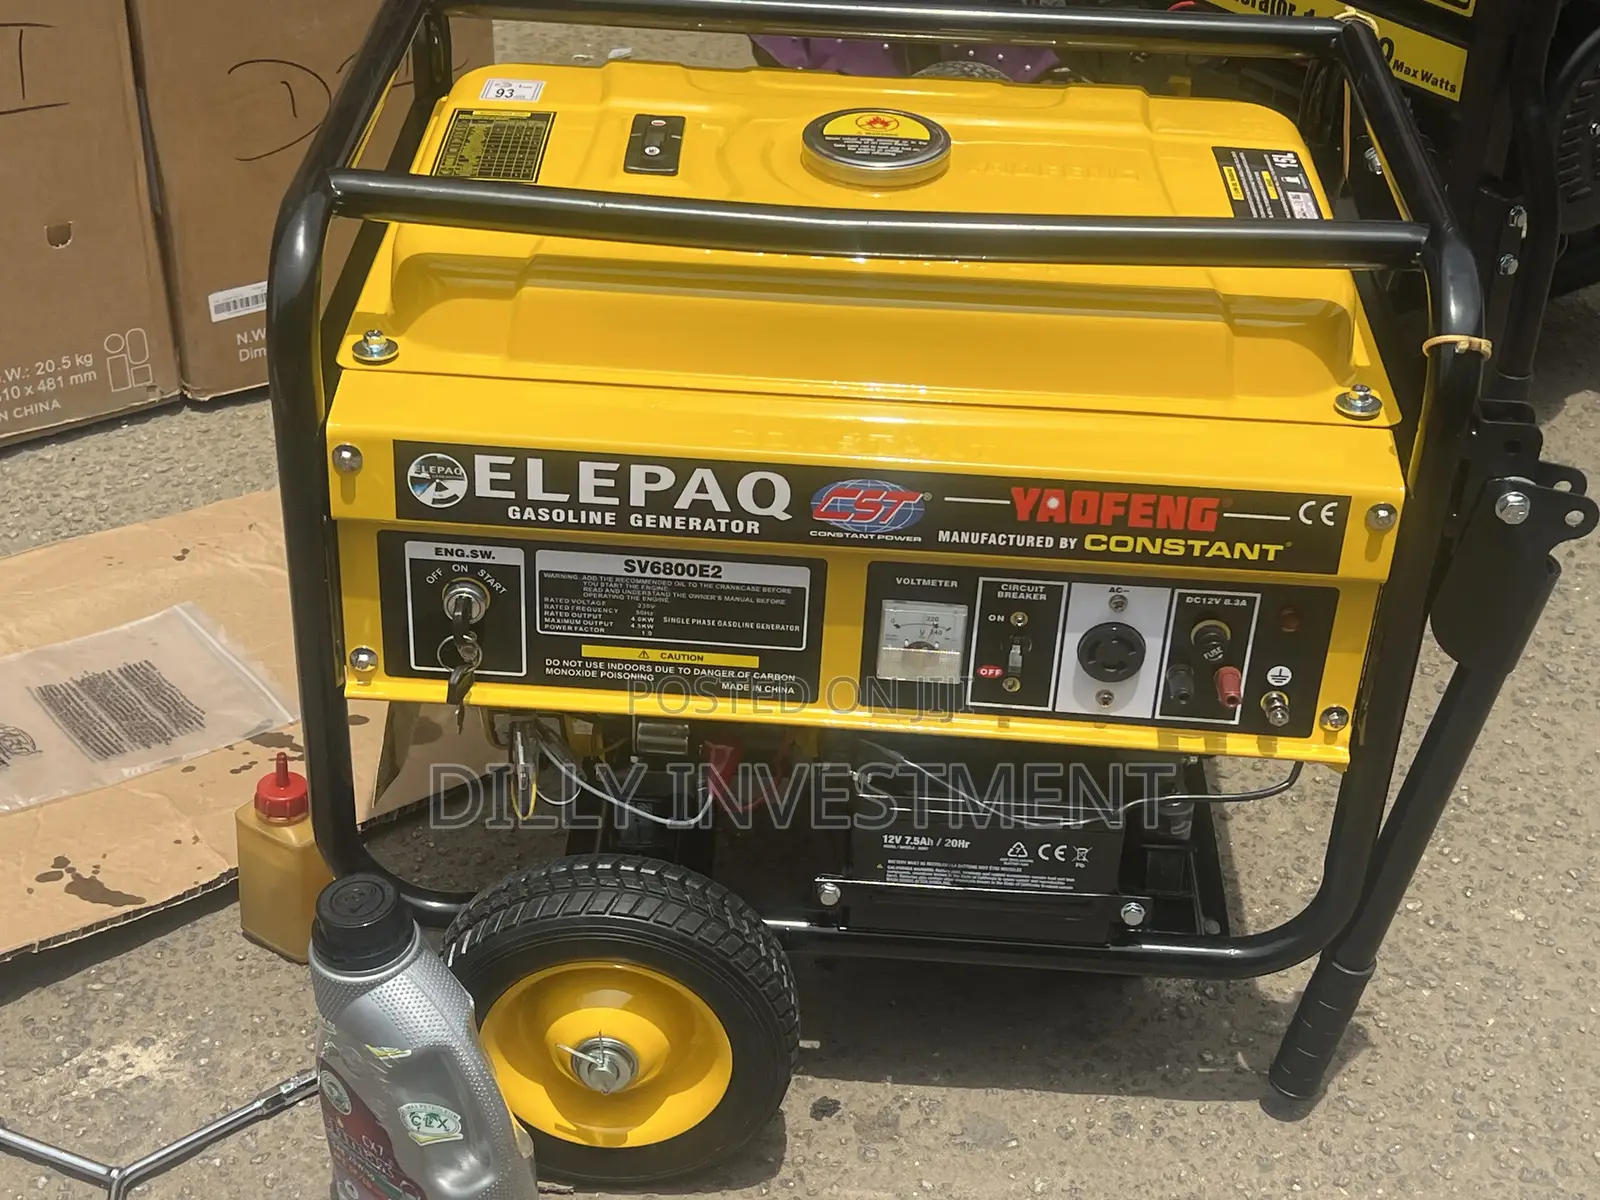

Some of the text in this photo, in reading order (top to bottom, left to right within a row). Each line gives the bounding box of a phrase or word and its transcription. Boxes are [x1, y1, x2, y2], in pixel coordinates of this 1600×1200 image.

[1392, 59, 1419, 78] Max
[1420, 69, 1457, 94] Watts
[494, 88, 515, 99] 93
[35, 355, 72, 375] 20.5
[75, 353, 93, 367] kg
[0, 370, 97, 402] 10 x 481 mm
[13, 399, 62, 419] CHINA
[474, 454, 793, 522] ELEPAQ
[812, 487, 924, 524] CST
[1011, 486, 1221, 532] YAOFENG
[507, 505, 760, 535] GASOLINE GENERATOR
[809, 530, 922, 543] CONSTANT POWER
[937, 529, 1284, 562] MANUFACTURED BY CONSTANT
[434, 547, 496, 560] ENG.SW.
[623, 559, 723, 579] SV6800E2
[425, 563, 508, 595] OFF ON START
[582, 574, 598, 582] ADD
[599, 575, 614, 583] THE
[615, 576, 673, 586] RECOMMENDED
[715, 583, 761, 592] CRANKCASE
[762, 587, 793, 595] BEFORE
[895, 577, 958, 588] VOLTMETER
[1000, 583, 1046, 593] CIRCUIT
[543, 596, 570, 604] RATED
[571, 598, 607, 606] VOLTAGE
[582, 586, 604, 594] READ
[621, 588, 671, 598] UNDERSTAND
[724, 595, 755, 604] MANUAL
[756, 597, 786, 605] BEFORE
[582, 592, 625, 600] OPERATING
[997, 590, 1047, 601] BREAKER
[1185, 596, 1222, 605] DC12V
[543, 603, 570, 611] RATED
[571, 605, 619, 614] FREQUENCY
[543, 610, 570, 618] RATED
[571, 611, 603, 619] OUTPUT
[543, 617, 581, 625] MAXIMUM
[582, 619, 614, 627] OUTPUT
[663, 616, 800, 632] SINGLE PHASE GASOLINE GENERATOR
[987, 614, 1005, 622] ON
[543, 624, 573, 632] POWER
[574, 625, 605, 633] FACTOR
[660, 652, 704, 662] CAUTION
[1203, 646, 1224, 660] FUSE
[545, 658, 796, 682] DO NOT USE INDOORS DUE TO DANGER OF CARBON
[545, 667, 655, 682] MONOXIDE POISONING
[979, 668, 1002, 676] OFF
[721, 682, 795, 695] MADE IN CHINA
[882, 834, 902, 845] 12V
[904, 835, 934, 846] 7.5Ah
[944, 838, 971, 849] 20Hr
